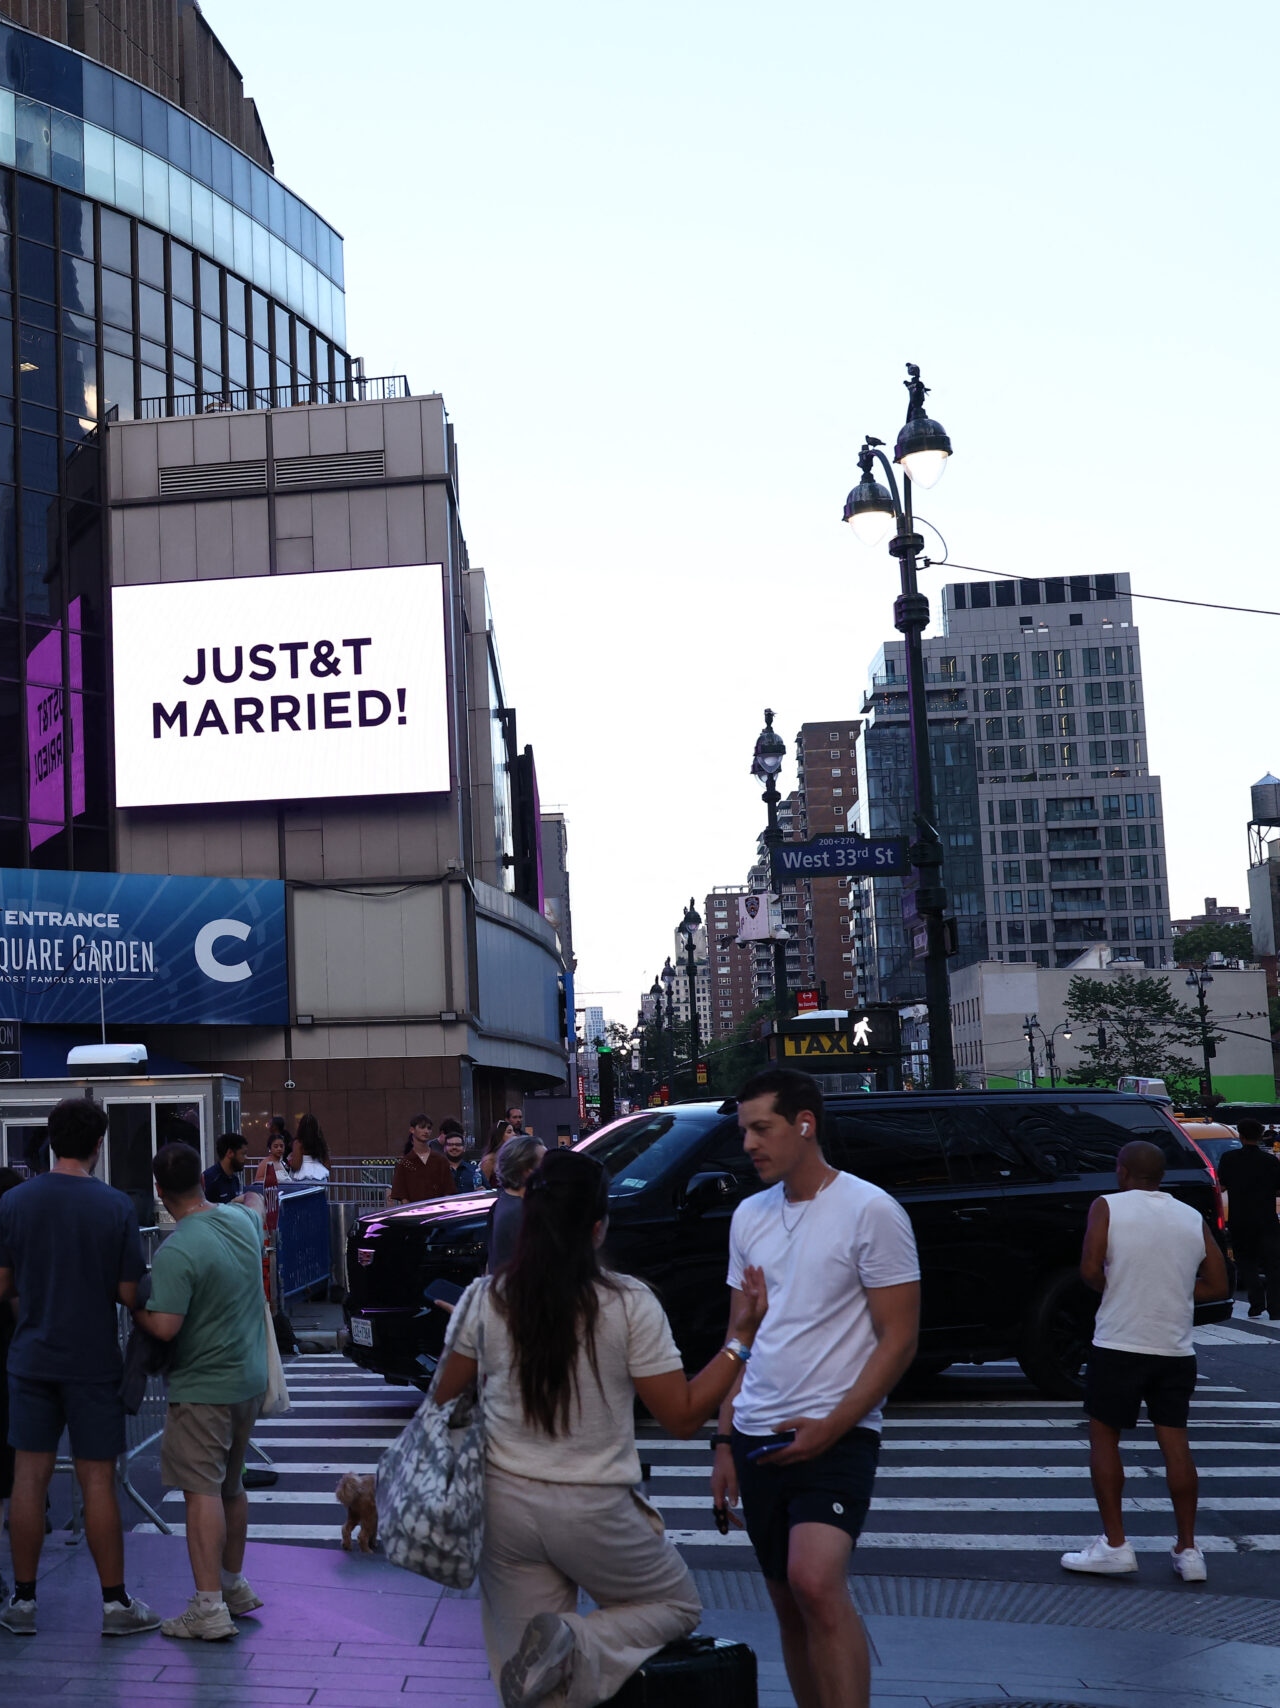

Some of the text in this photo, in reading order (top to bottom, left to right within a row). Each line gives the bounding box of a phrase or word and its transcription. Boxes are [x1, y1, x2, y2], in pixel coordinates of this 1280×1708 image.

[183, 637, 372, 686] JUST&T
[152, 687, 407, 739] MARRIED!
[818, 837, 856, 846] 200 270
[782, 847, 895, 869] West 33rd St
[4, 910, 120, 929] ENTRANCE
[72, 934, 154, 973] GARDEN
[194, 918, 253, 983] C
[30, 976, 75, 985] FAMOUS
[79, 977, 115, 985] ARENA
[788, 1033, 848, 1054] TAX
